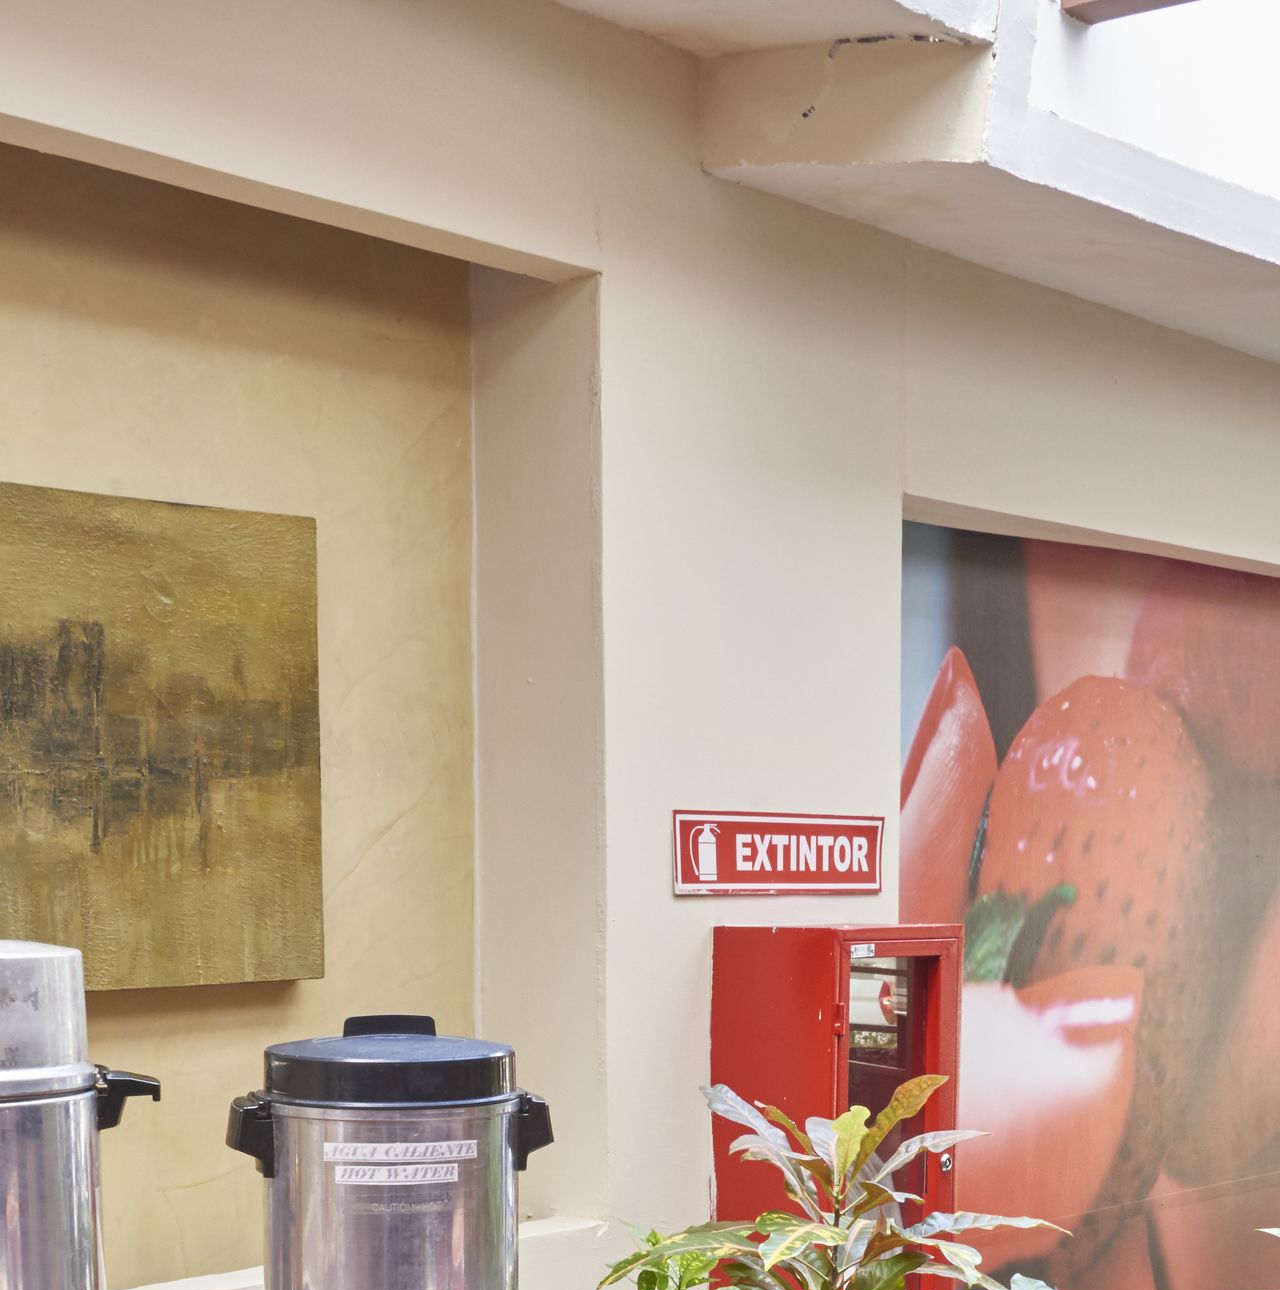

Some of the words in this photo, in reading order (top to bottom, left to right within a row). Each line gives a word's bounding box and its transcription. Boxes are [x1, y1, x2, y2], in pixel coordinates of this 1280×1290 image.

[735, 833, 869, 873] EXTINTOR
[325, 1145, 377, 1159] AGUA
[385, 1143, 475, 1158] CALIENTE
[340, 1167, 379, 1179] HOT
[386, 1166, 455, 1179] WATER
